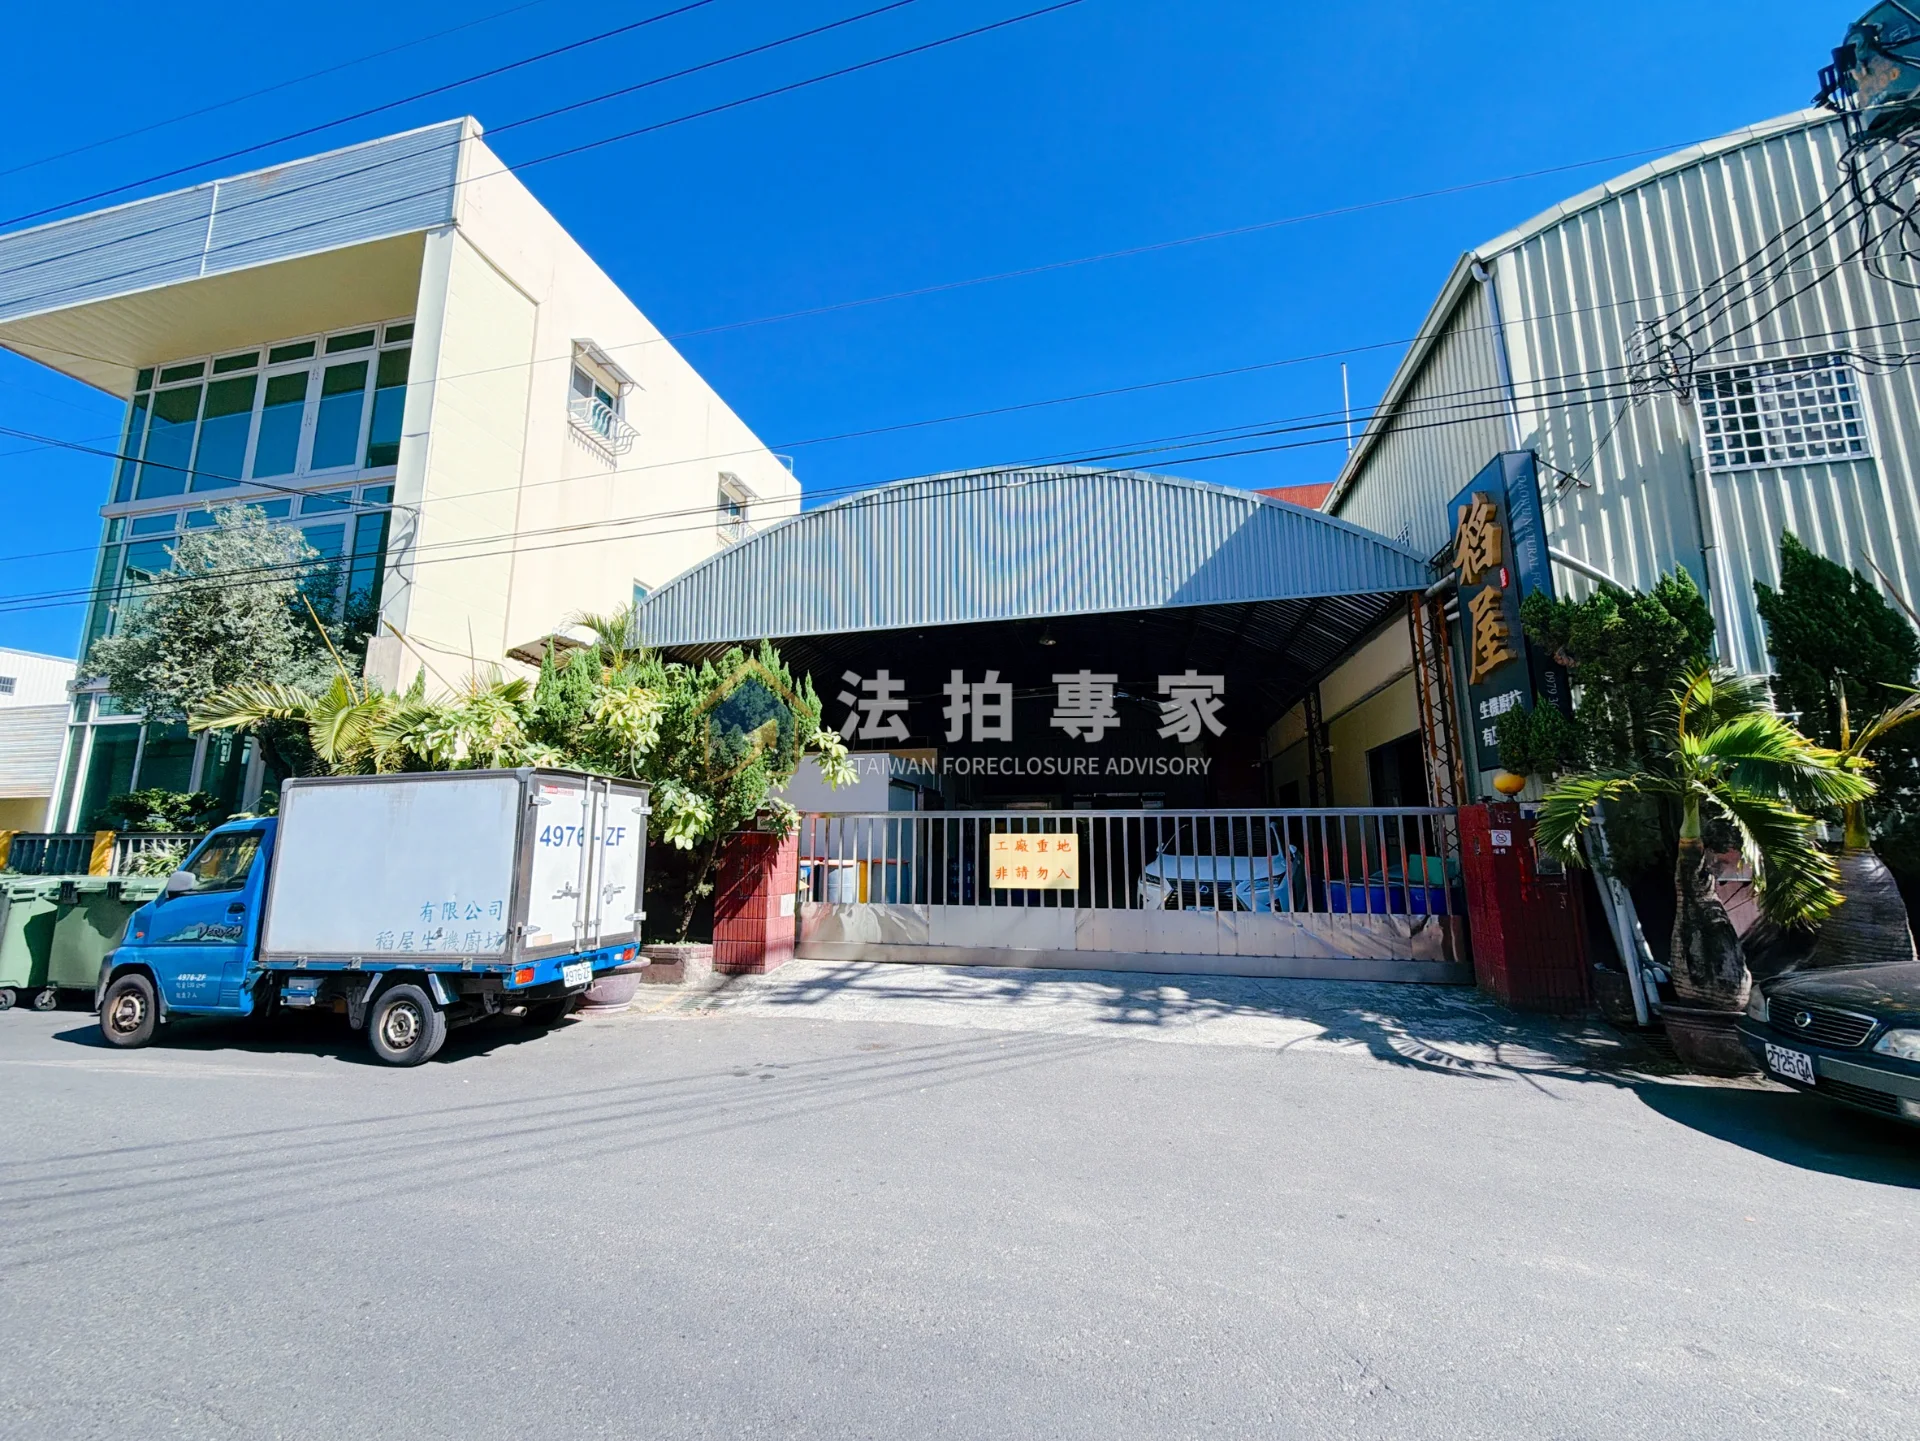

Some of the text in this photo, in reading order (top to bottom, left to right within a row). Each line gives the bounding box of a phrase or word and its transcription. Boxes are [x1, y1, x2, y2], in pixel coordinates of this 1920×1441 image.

[1522, 515, 1539, 570] NATURAL
[1452, 490, 1517, 686] 稻屋
[1544, 671, 1558, 695] 0979
[994, 838, 1072, 853] 工廠重地
[995, 865, 1072, 880] 非請勿入
[419, 899, 503, 923] 有限公司
[375, 929, 507, 953] 稻屋生機廚坊
[177, 973, 207, 981] 4976-ZF
